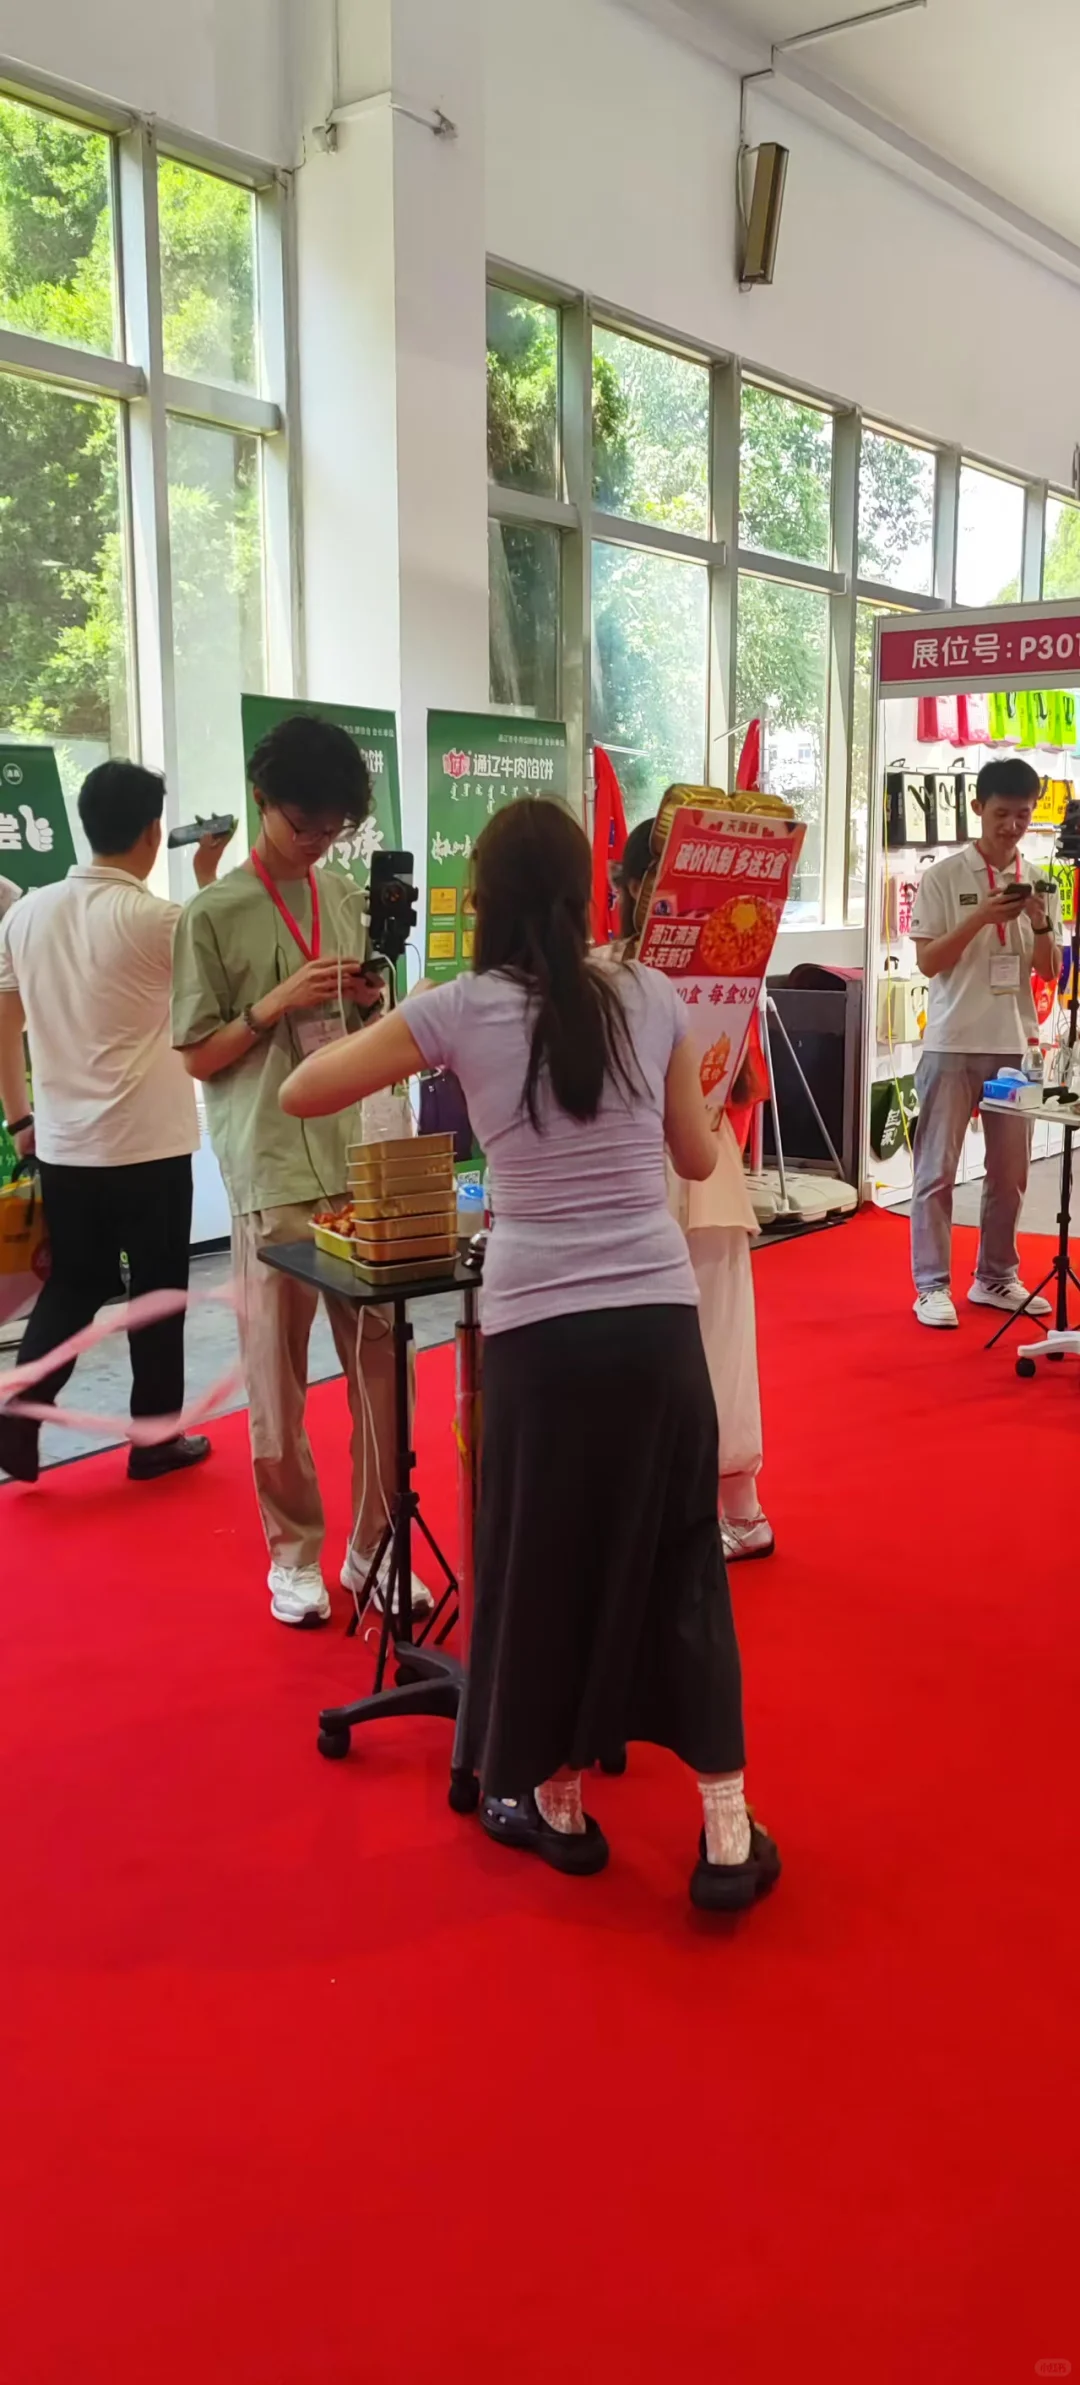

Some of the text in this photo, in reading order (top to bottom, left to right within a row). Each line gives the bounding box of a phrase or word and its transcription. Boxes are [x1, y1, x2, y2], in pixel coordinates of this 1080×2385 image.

[473, 753, 554, 780] 通辽牛肉馅饼
[673, 841, 789, 880] 破价机制 多送3盒
